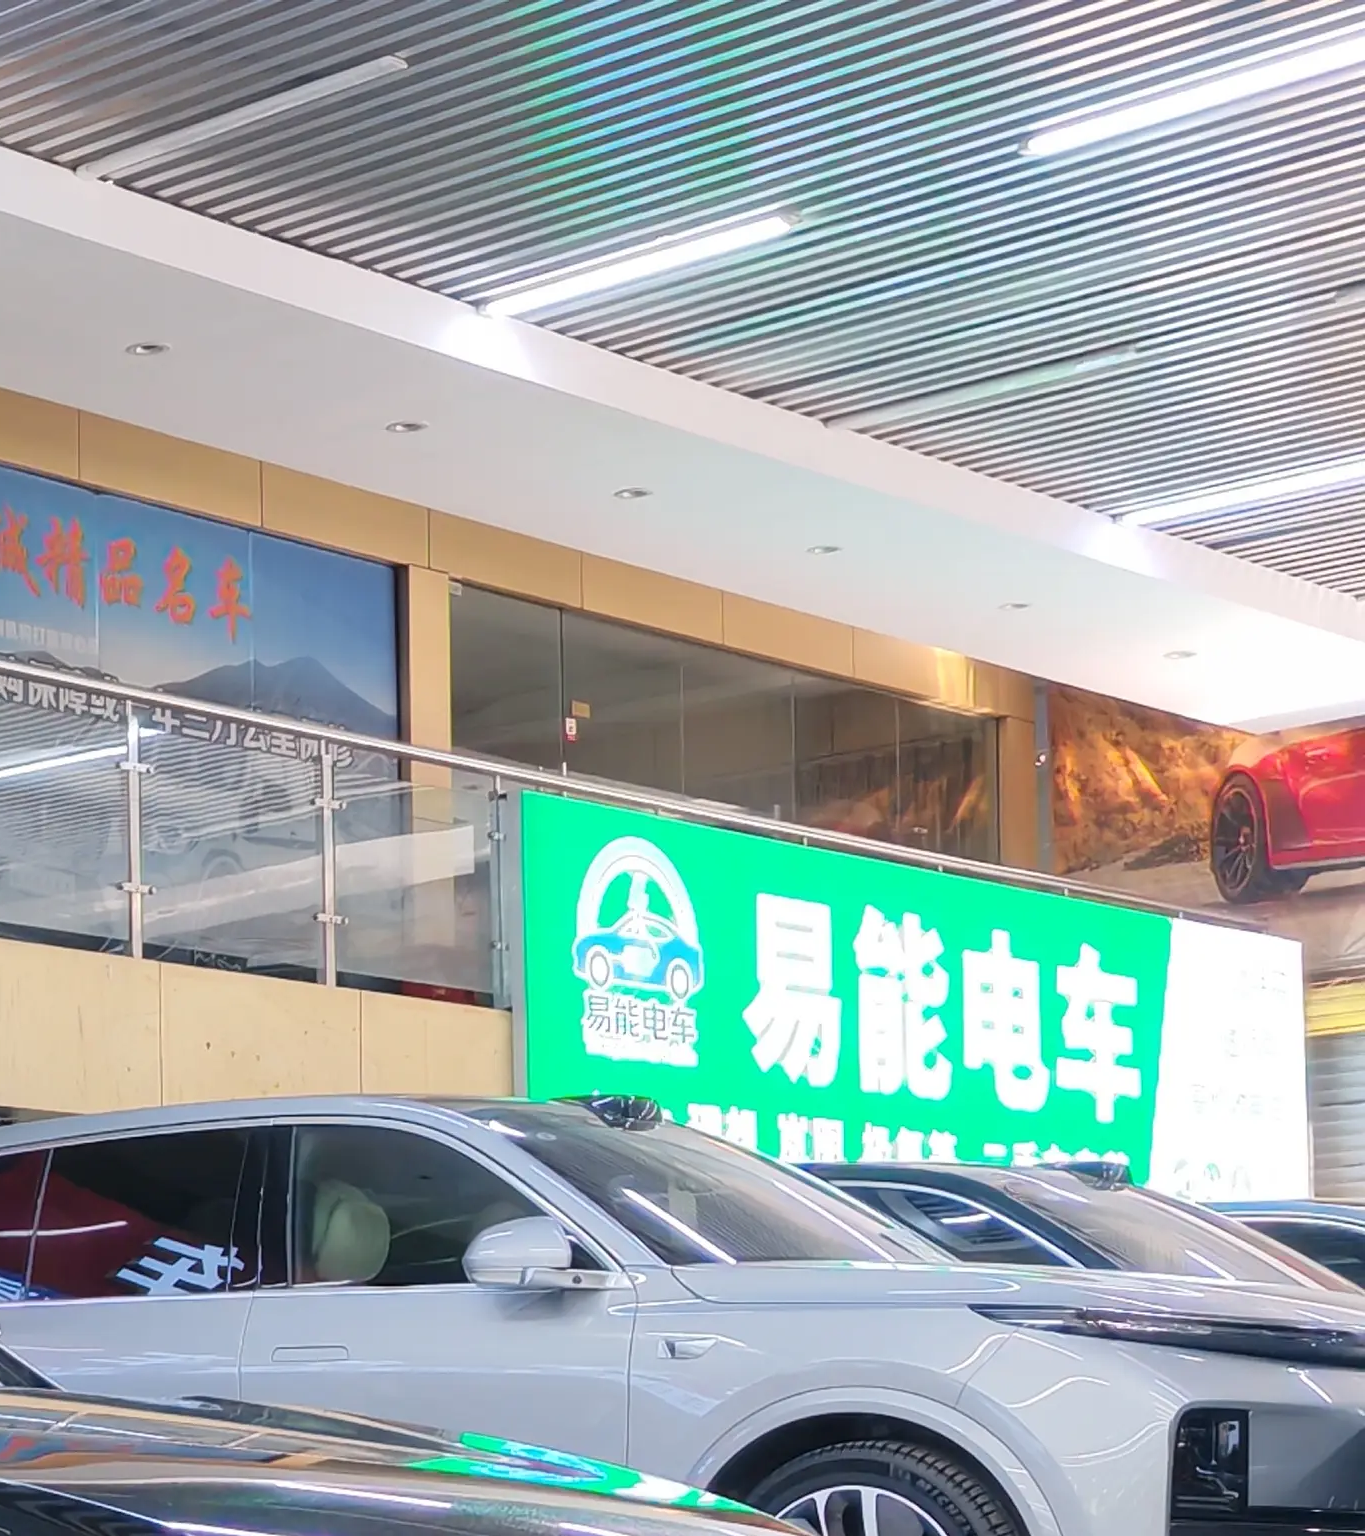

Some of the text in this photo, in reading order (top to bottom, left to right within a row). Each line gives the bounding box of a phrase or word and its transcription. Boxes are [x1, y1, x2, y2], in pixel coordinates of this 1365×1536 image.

[587, 994, 695, 1043] 易能电车
[742, 892, 1143, 1124] 易能电车
